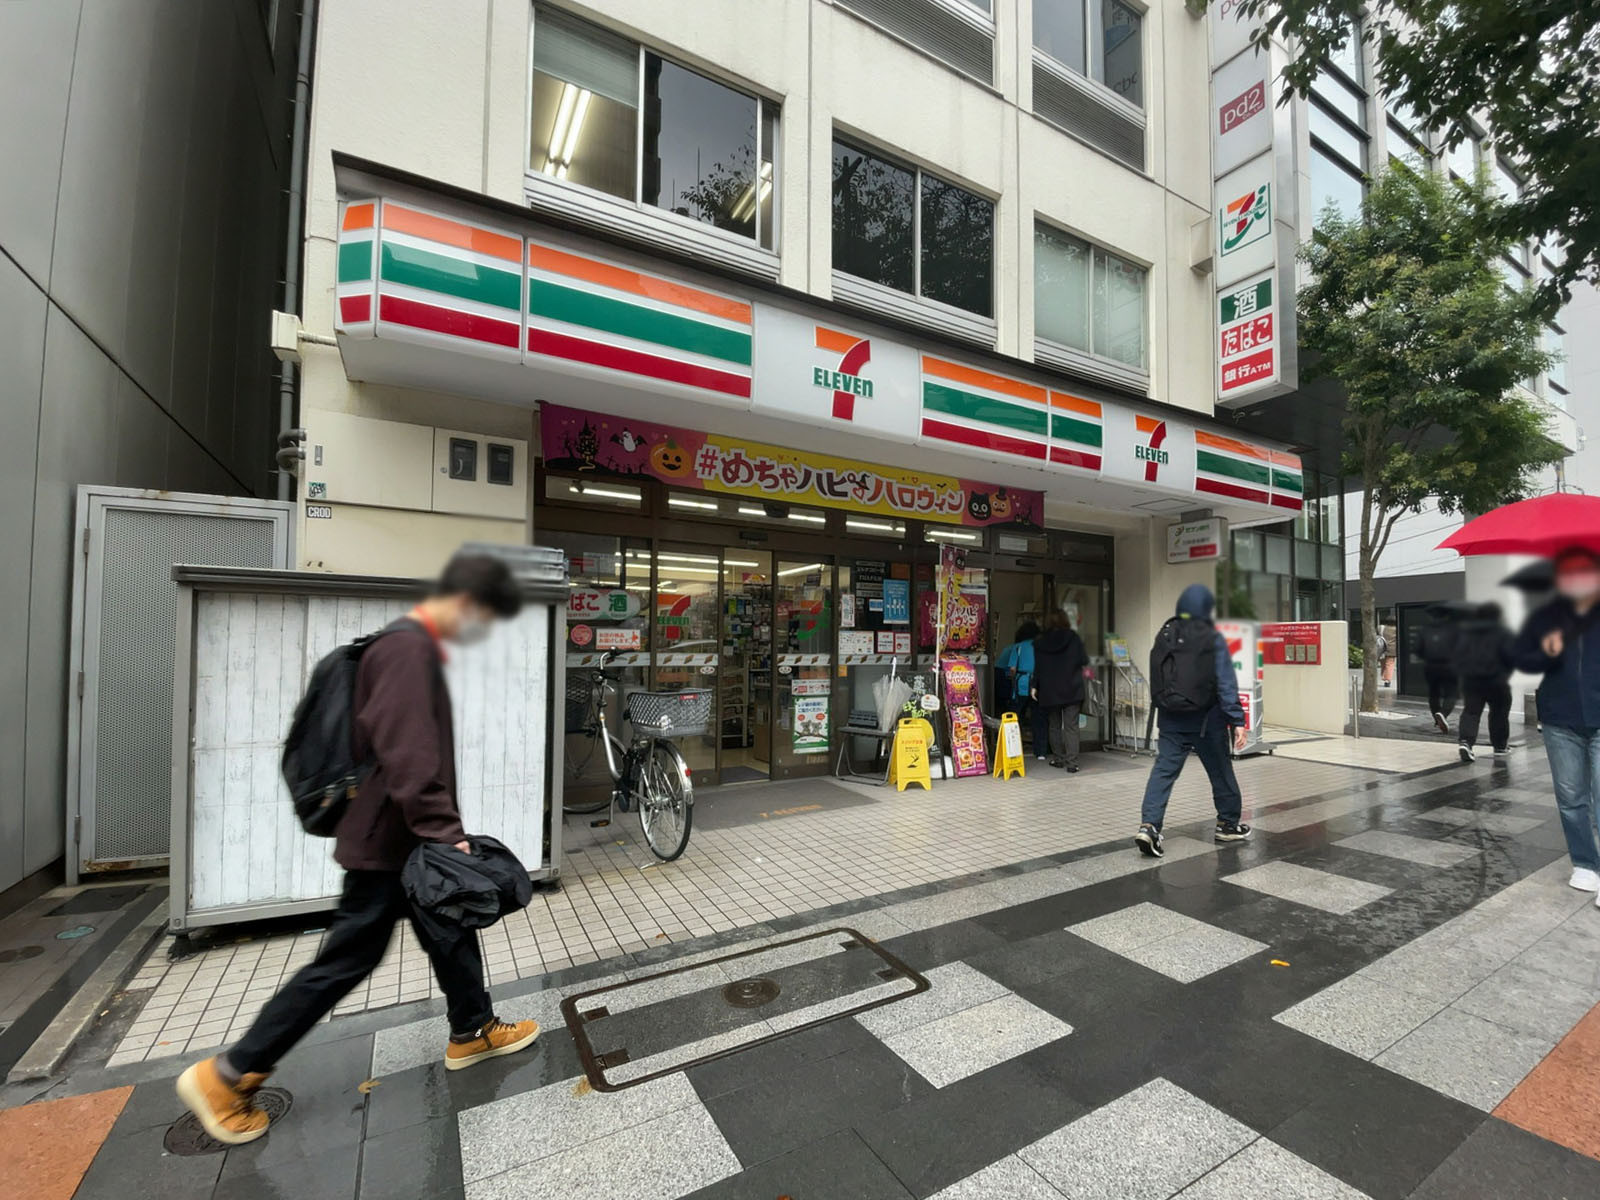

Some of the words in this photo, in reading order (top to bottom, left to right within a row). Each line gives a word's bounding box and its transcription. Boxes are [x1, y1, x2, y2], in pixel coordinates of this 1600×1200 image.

[1224, 88, 1261, 130] pd2
[1233, 285, 1258, 320] 酒
[1224, 317, 1271, 357] たばこ
[1224, 361, 1271, 383] 銀行ATM
[568, 593, 600, 611] ばこ
[609, 594, 627, 612] 酒
